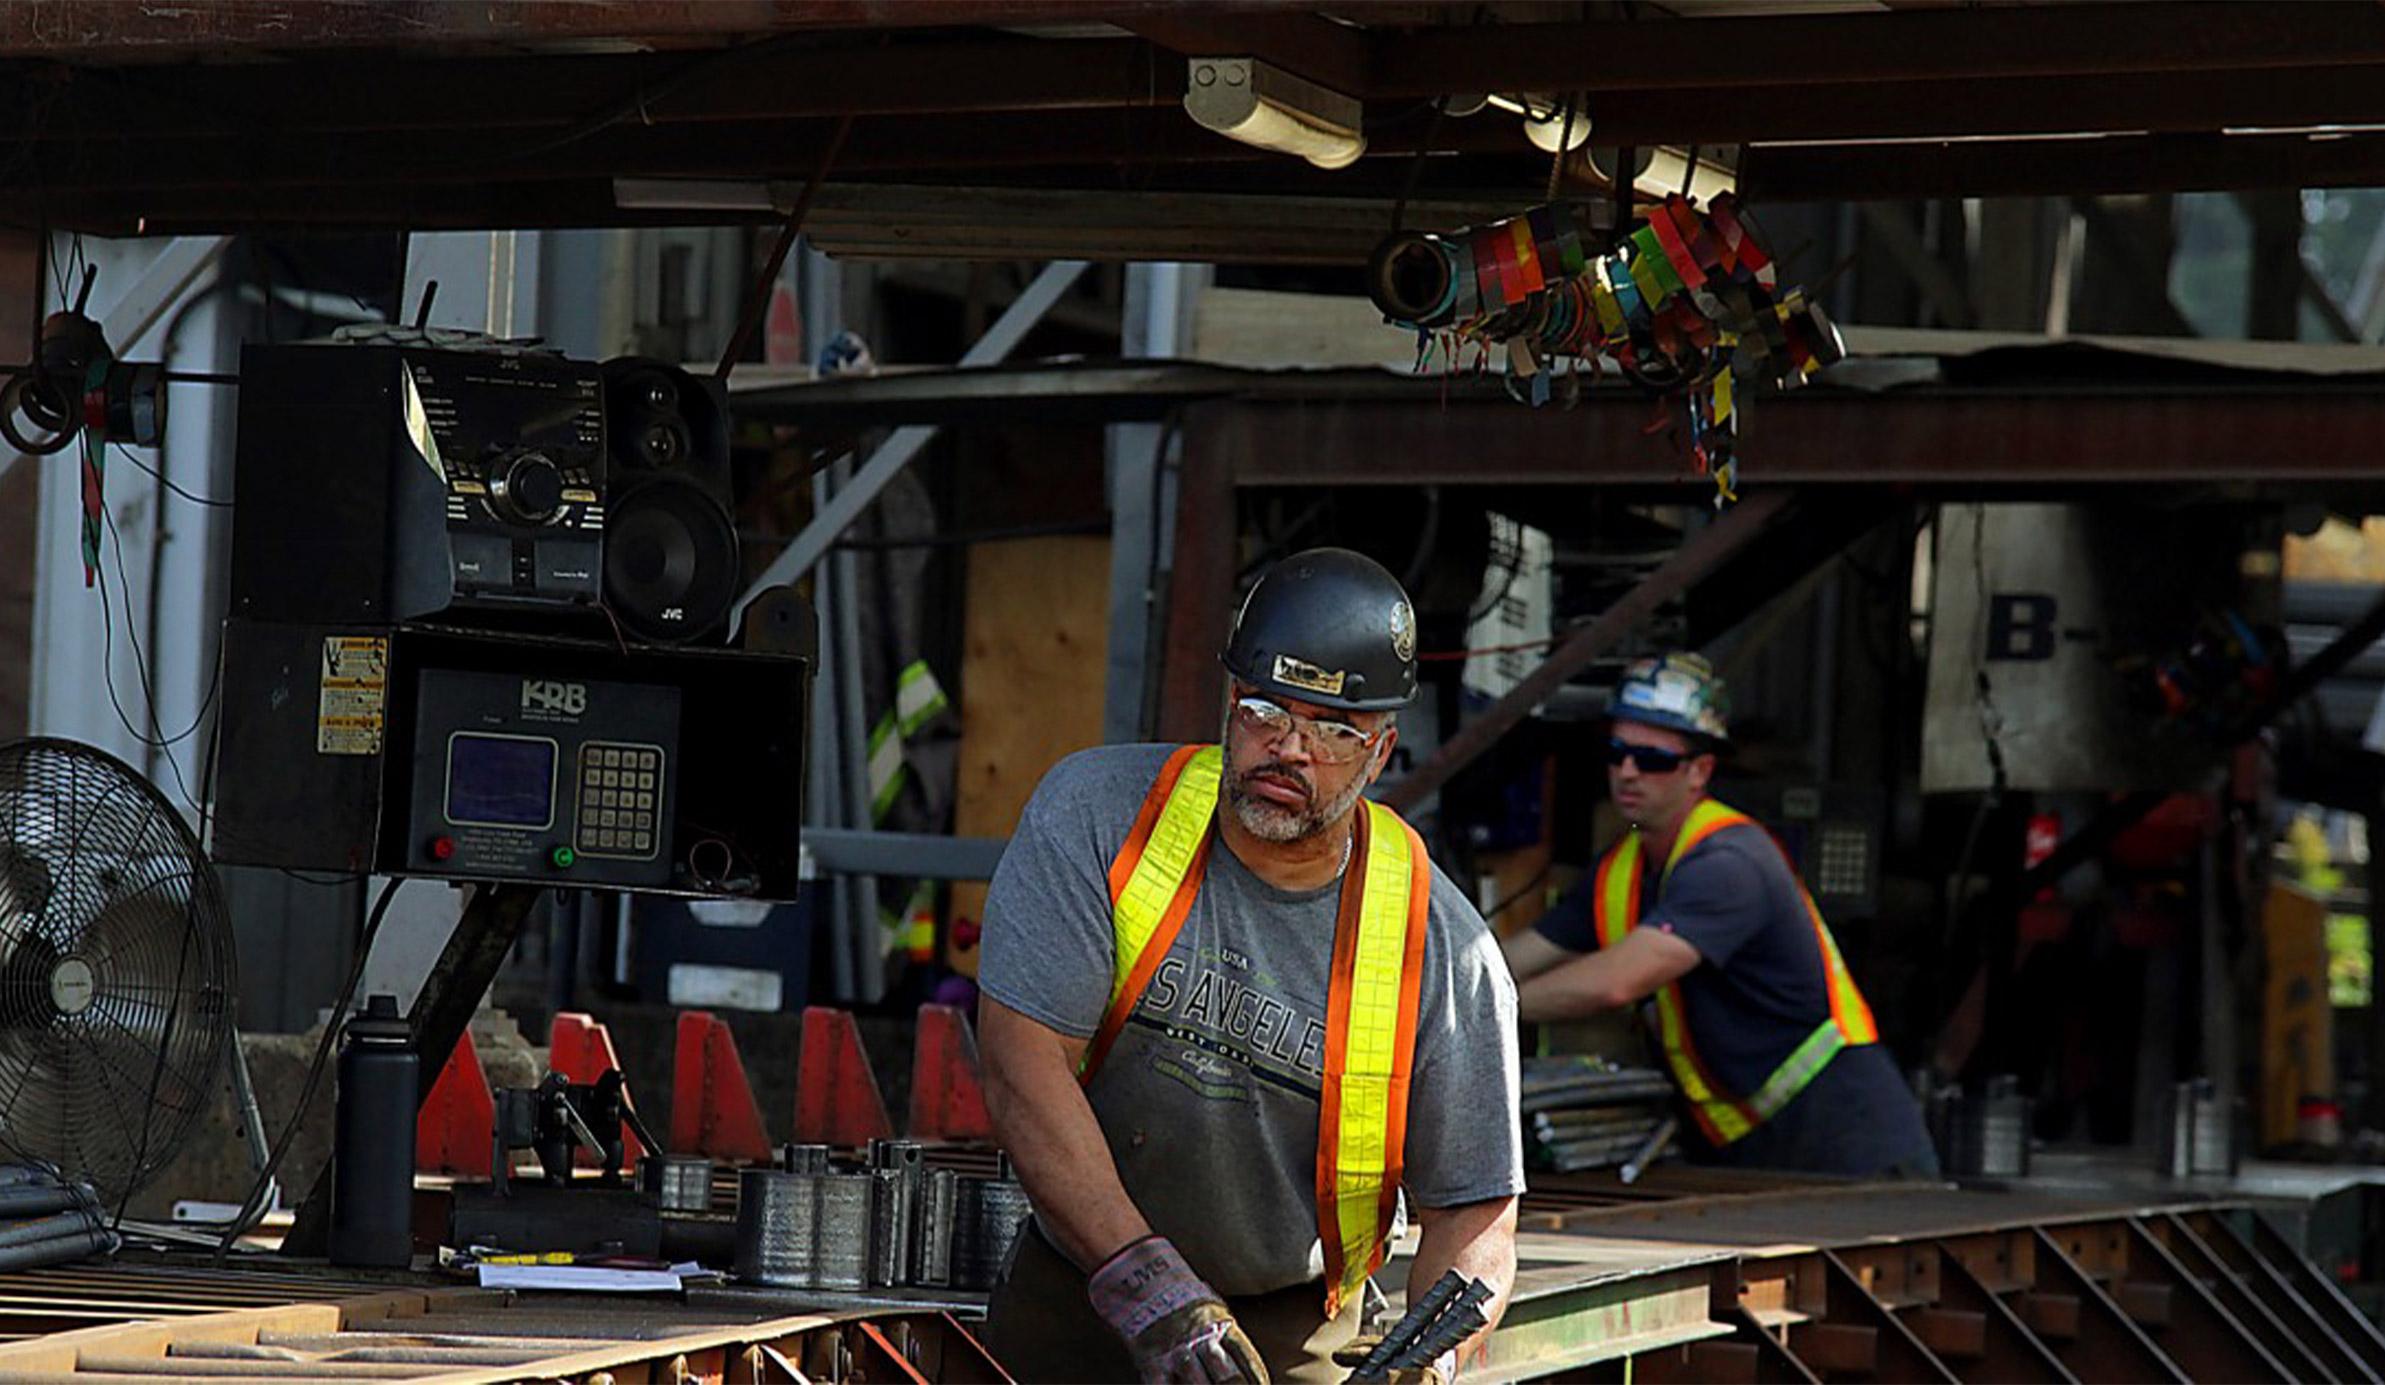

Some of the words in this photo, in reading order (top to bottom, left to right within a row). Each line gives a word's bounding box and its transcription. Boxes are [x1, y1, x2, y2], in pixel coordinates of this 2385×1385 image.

[661, 608, 682, 620] JVC
[521, 679, 588, 714] KRB
[1221, 949, 1248, 971] USA
[1138, 957, 1186, 1012] S
[1180, 968, 1324, 1079] ANGELE
[1166, 1027, 1206, 1046] WEST
